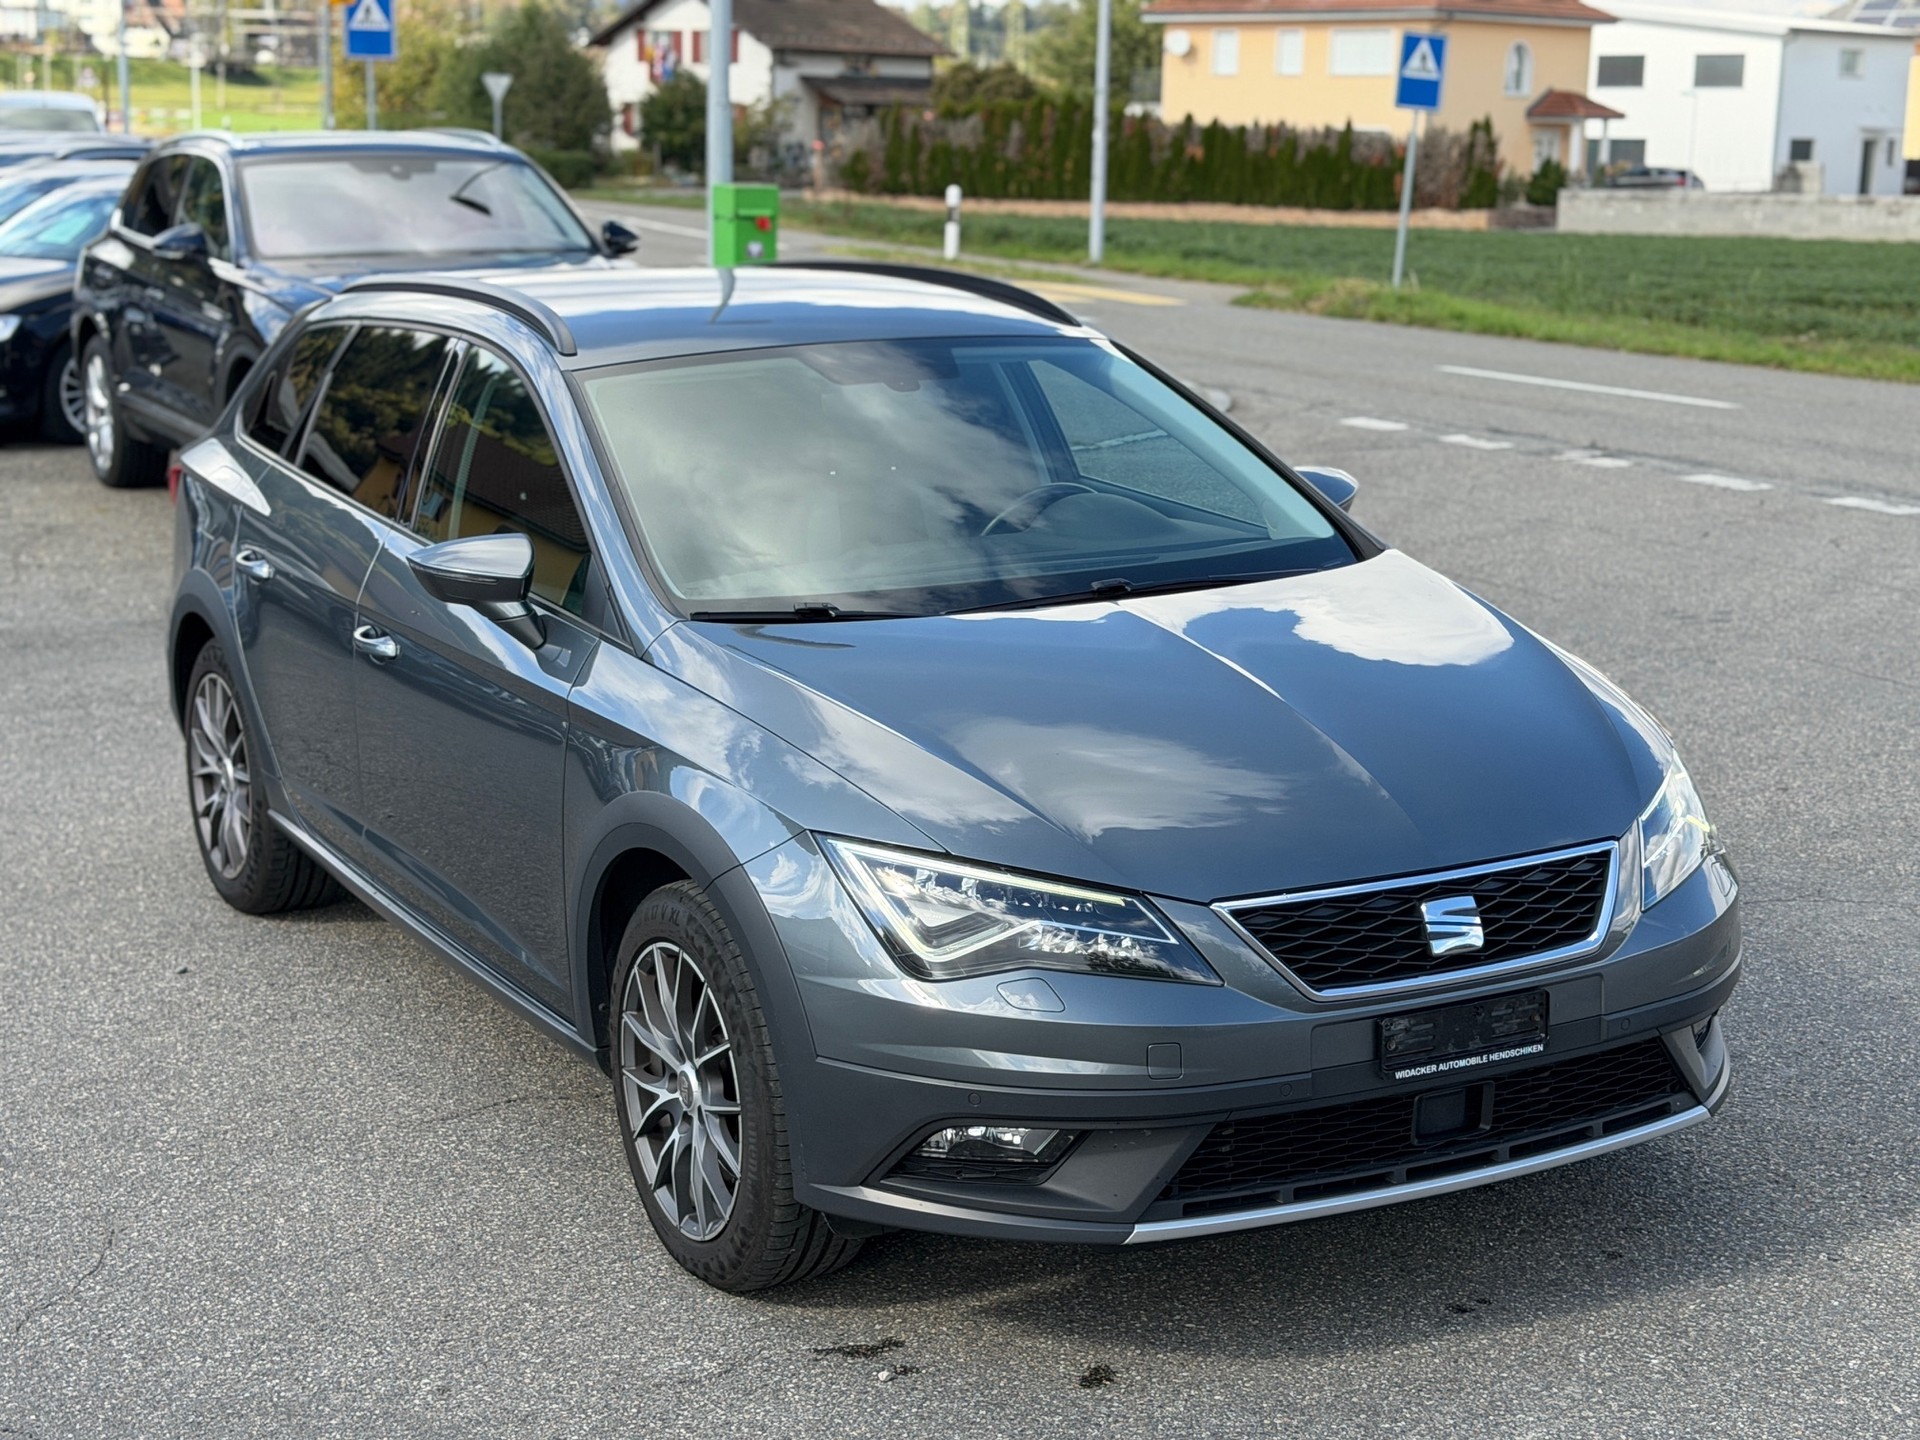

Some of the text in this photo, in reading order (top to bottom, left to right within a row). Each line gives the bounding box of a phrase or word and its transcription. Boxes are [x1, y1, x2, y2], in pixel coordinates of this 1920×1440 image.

[1395, 1043, 1544, 1079] WIDACKER AUTOMOBILE HENDSCHIKEN
